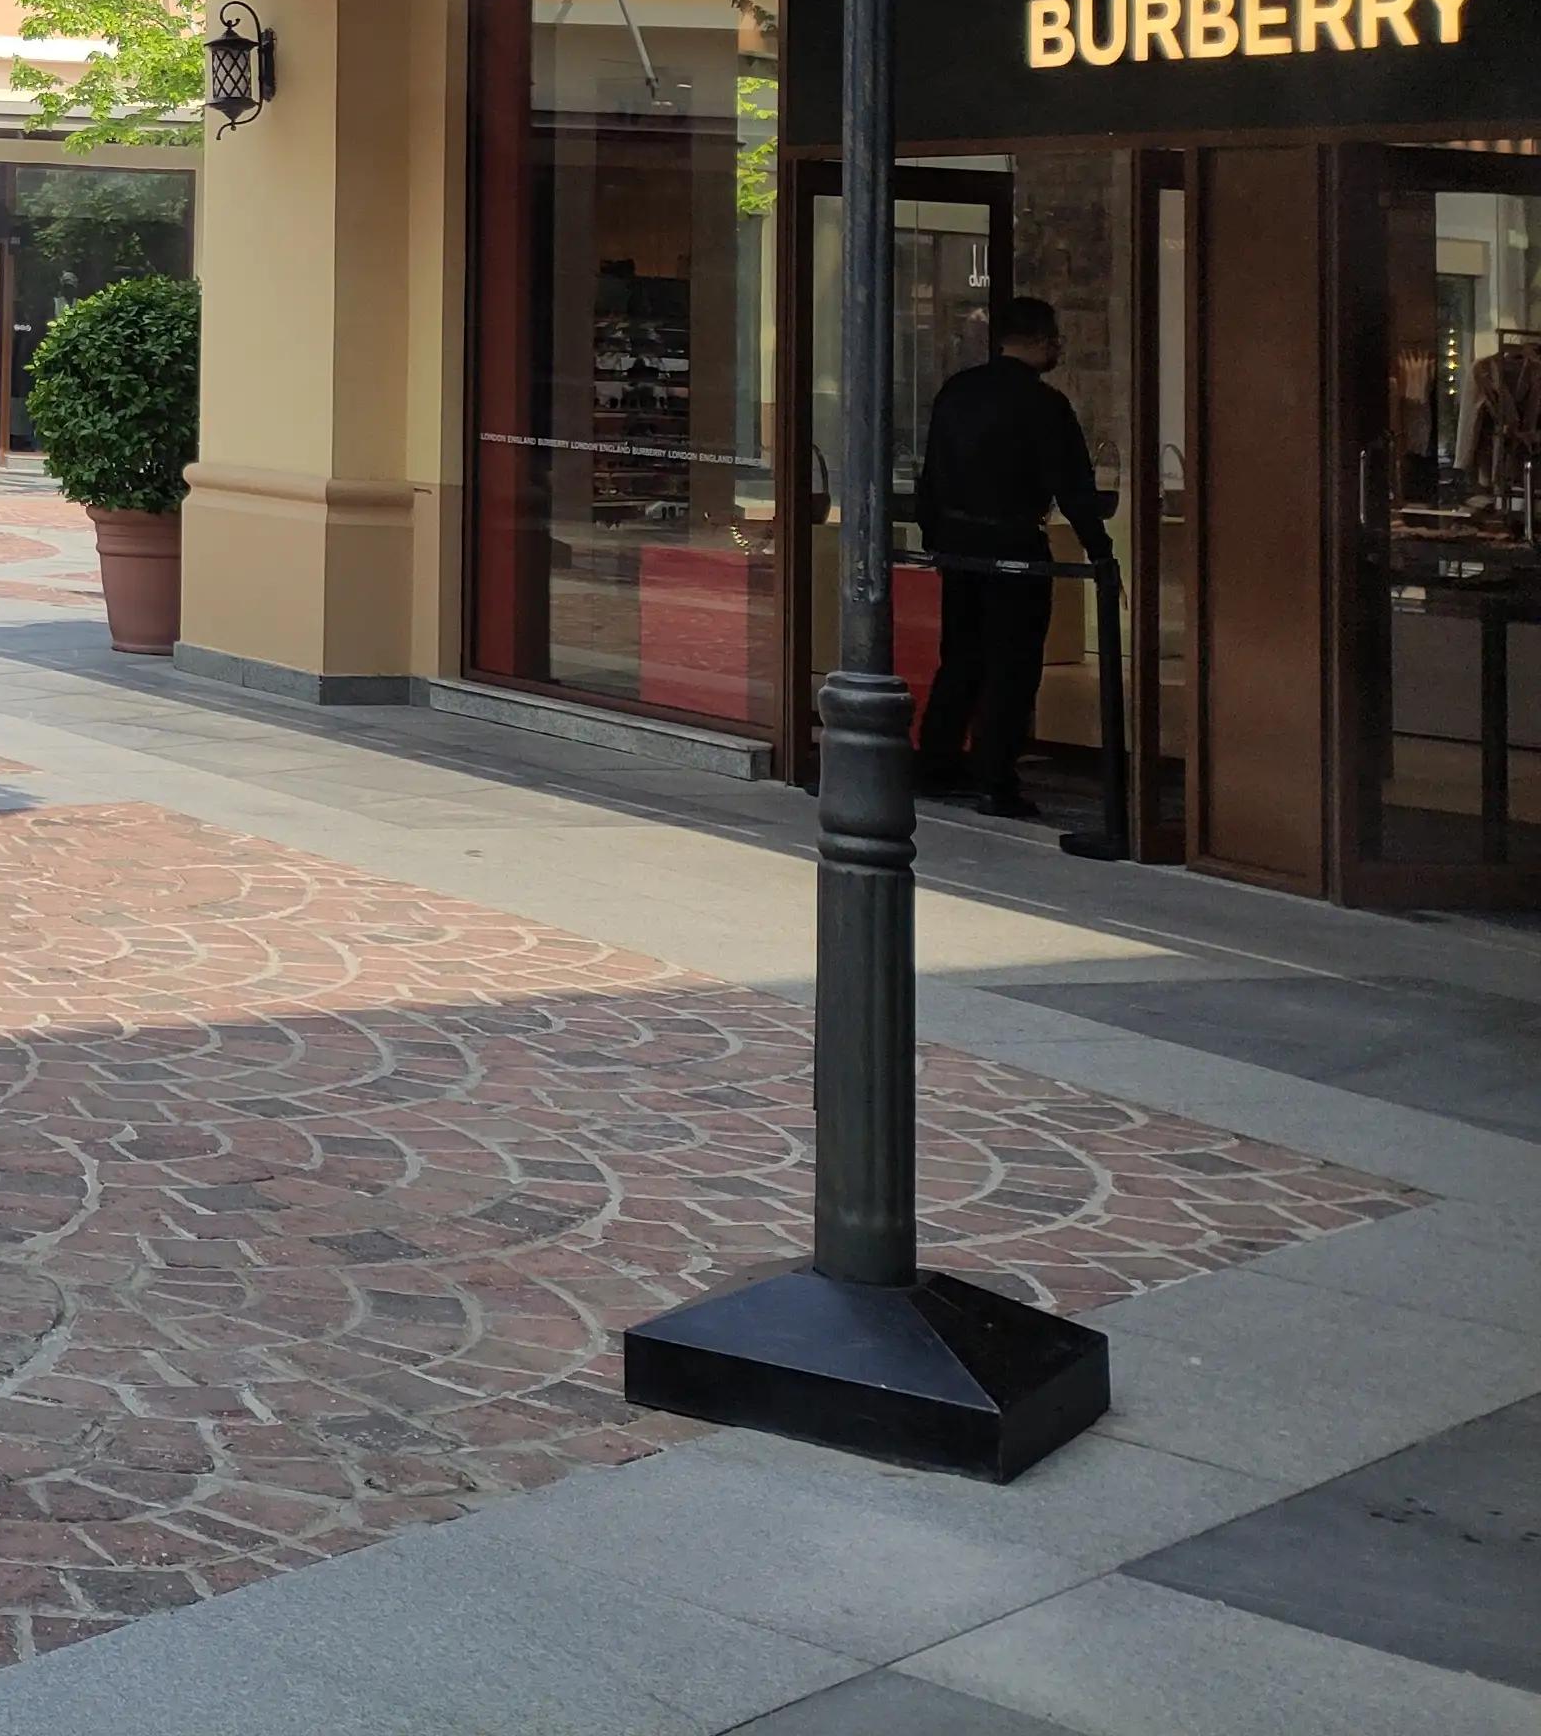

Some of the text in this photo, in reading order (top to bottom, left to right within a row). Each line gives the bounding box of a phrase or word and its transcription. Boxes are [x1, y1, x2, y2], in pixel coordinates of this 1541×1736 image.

[480, 432, 506, 443] LONDON
[508, 435, 537, 446] ENGLAND
[571, 440, 598, 451] LONDON
[599, 442, 631, 454] ENGLAND
[632, 446, 667, 458] BURBERRY
[668, 450, 698, 461] LONDON
[699, 452, 734, 464] ENGLAND
